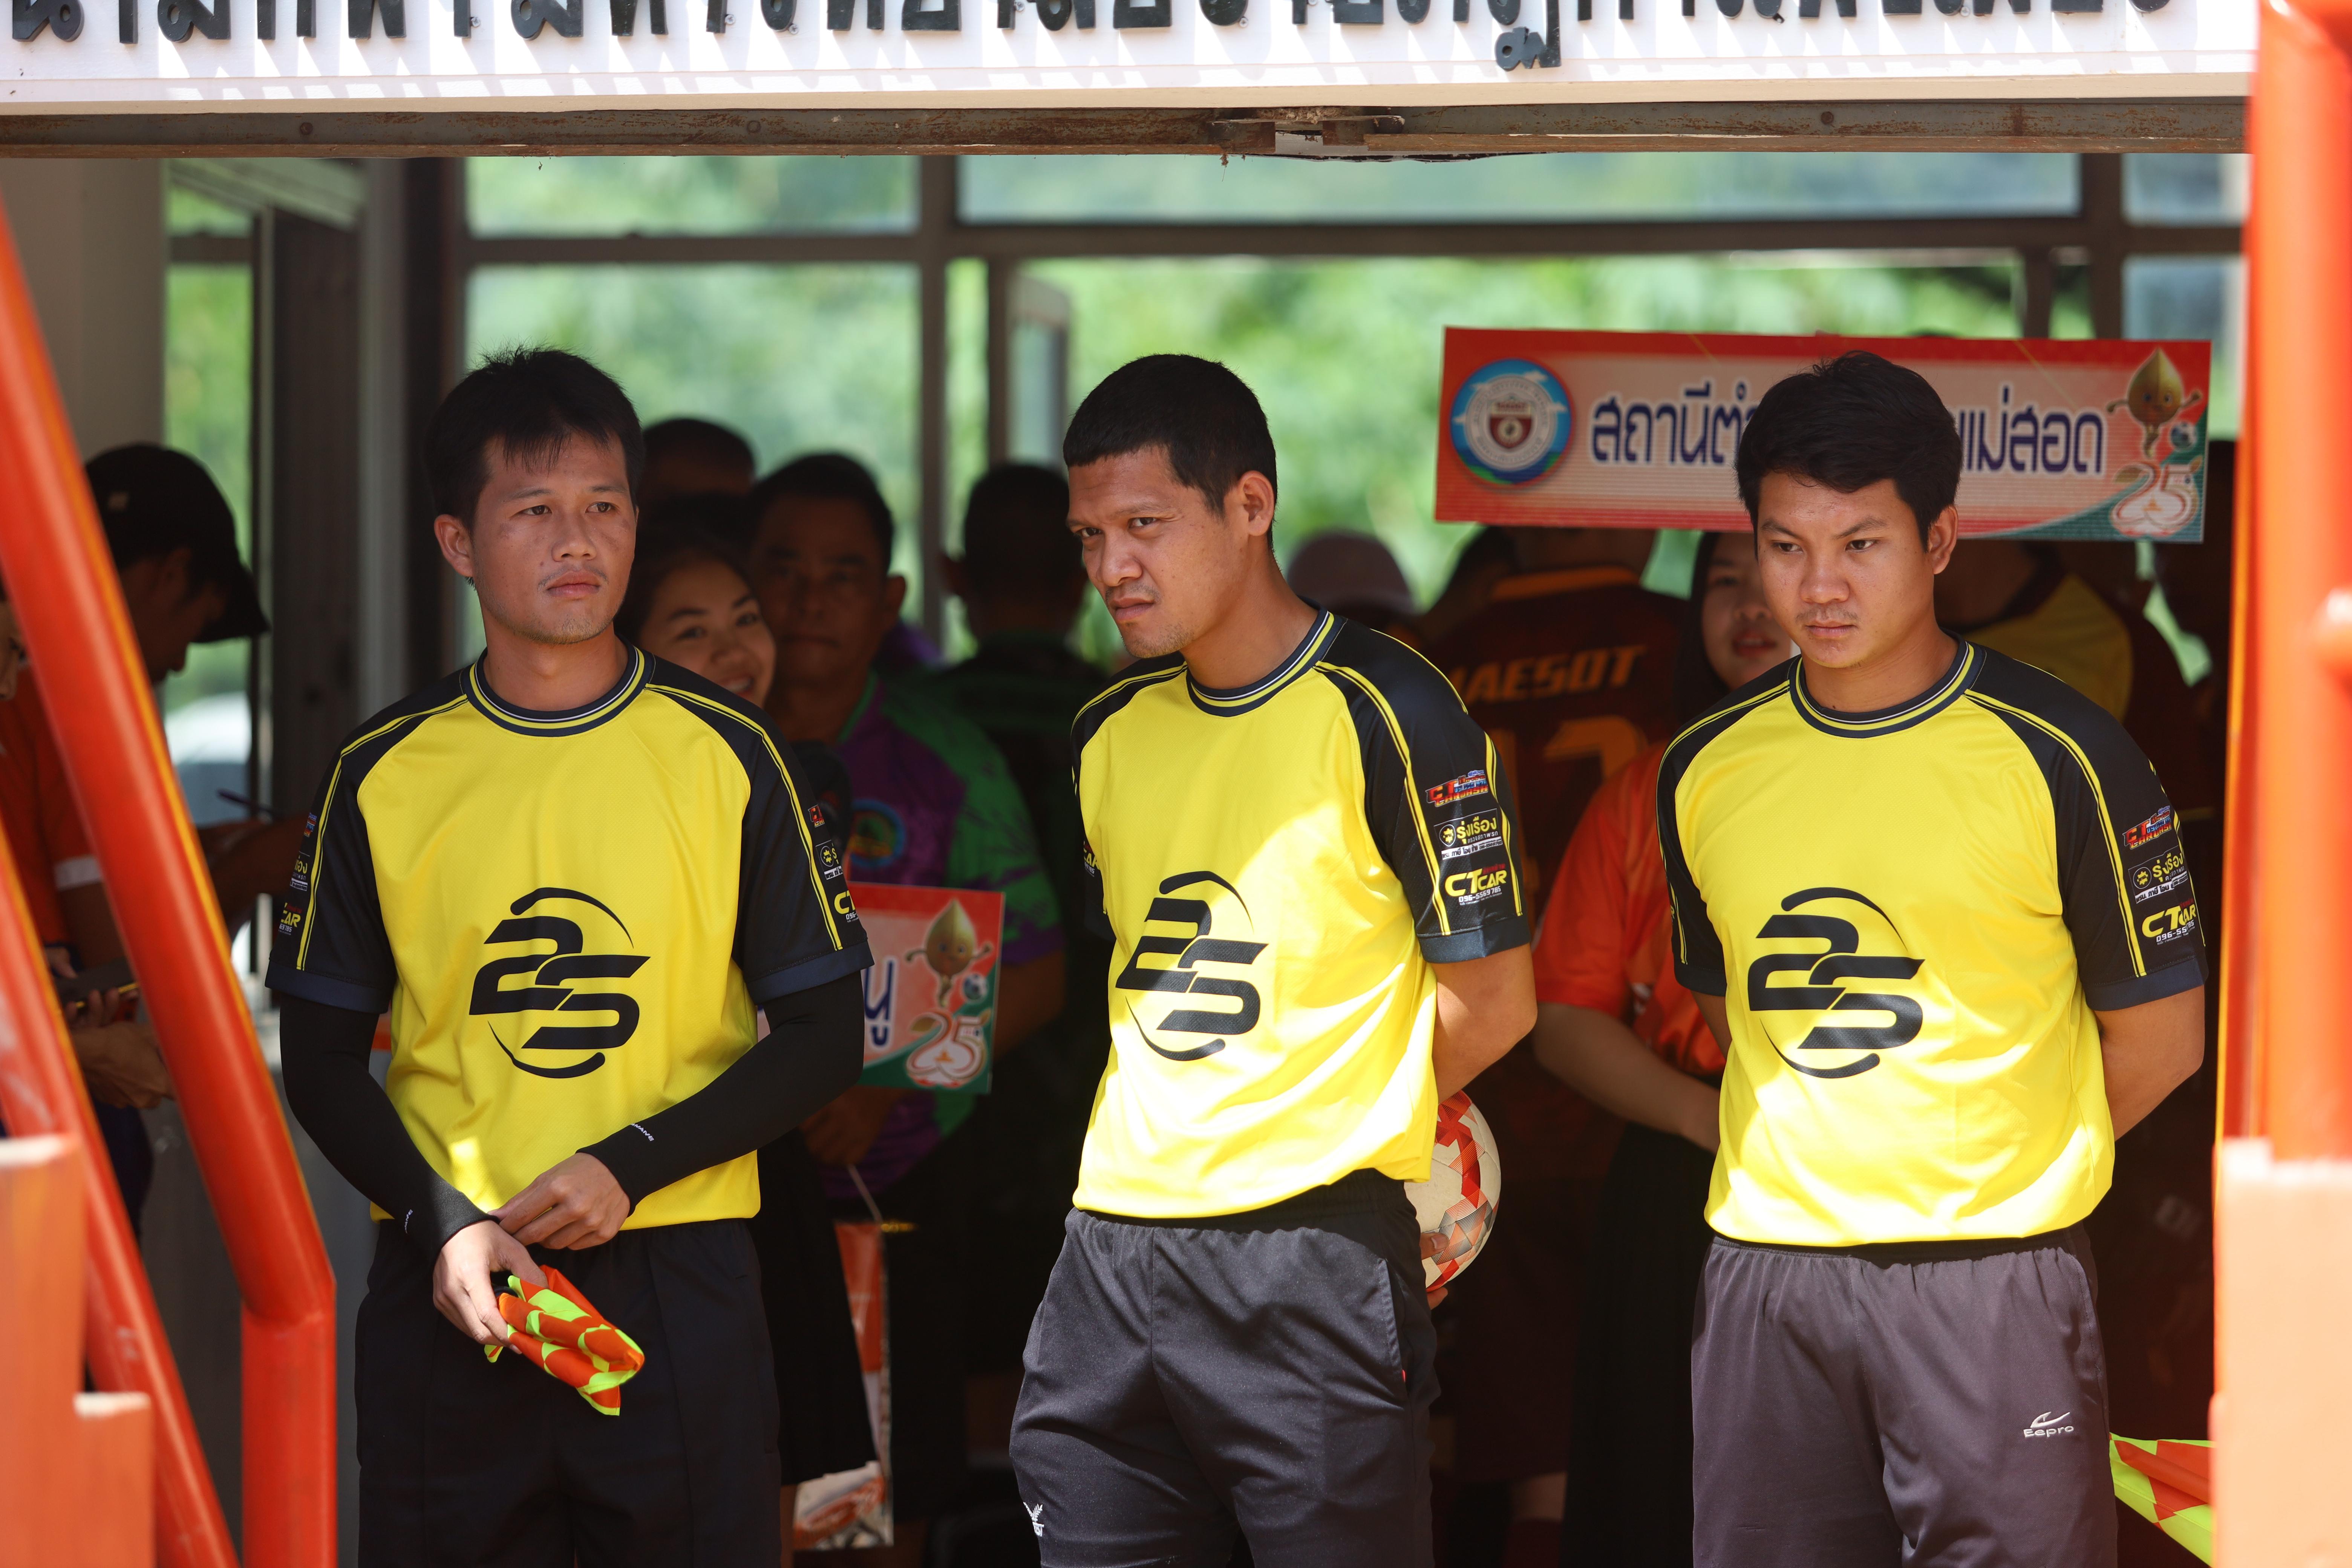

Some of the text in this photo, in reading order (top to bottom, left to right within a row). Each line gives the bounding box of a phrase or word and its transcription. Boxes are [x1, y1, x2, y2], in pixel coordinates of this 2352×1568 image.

[1593, 381, 1759, 464] สถานีตำ
[1959, 385, 2103, 473] แม่สอด
[1457, 816, 1497, 844] รุ่งเรือง
[1459, 885, 1501, 903] 096-5569785
[2023, 1426, 2074, 1438] Eepro
